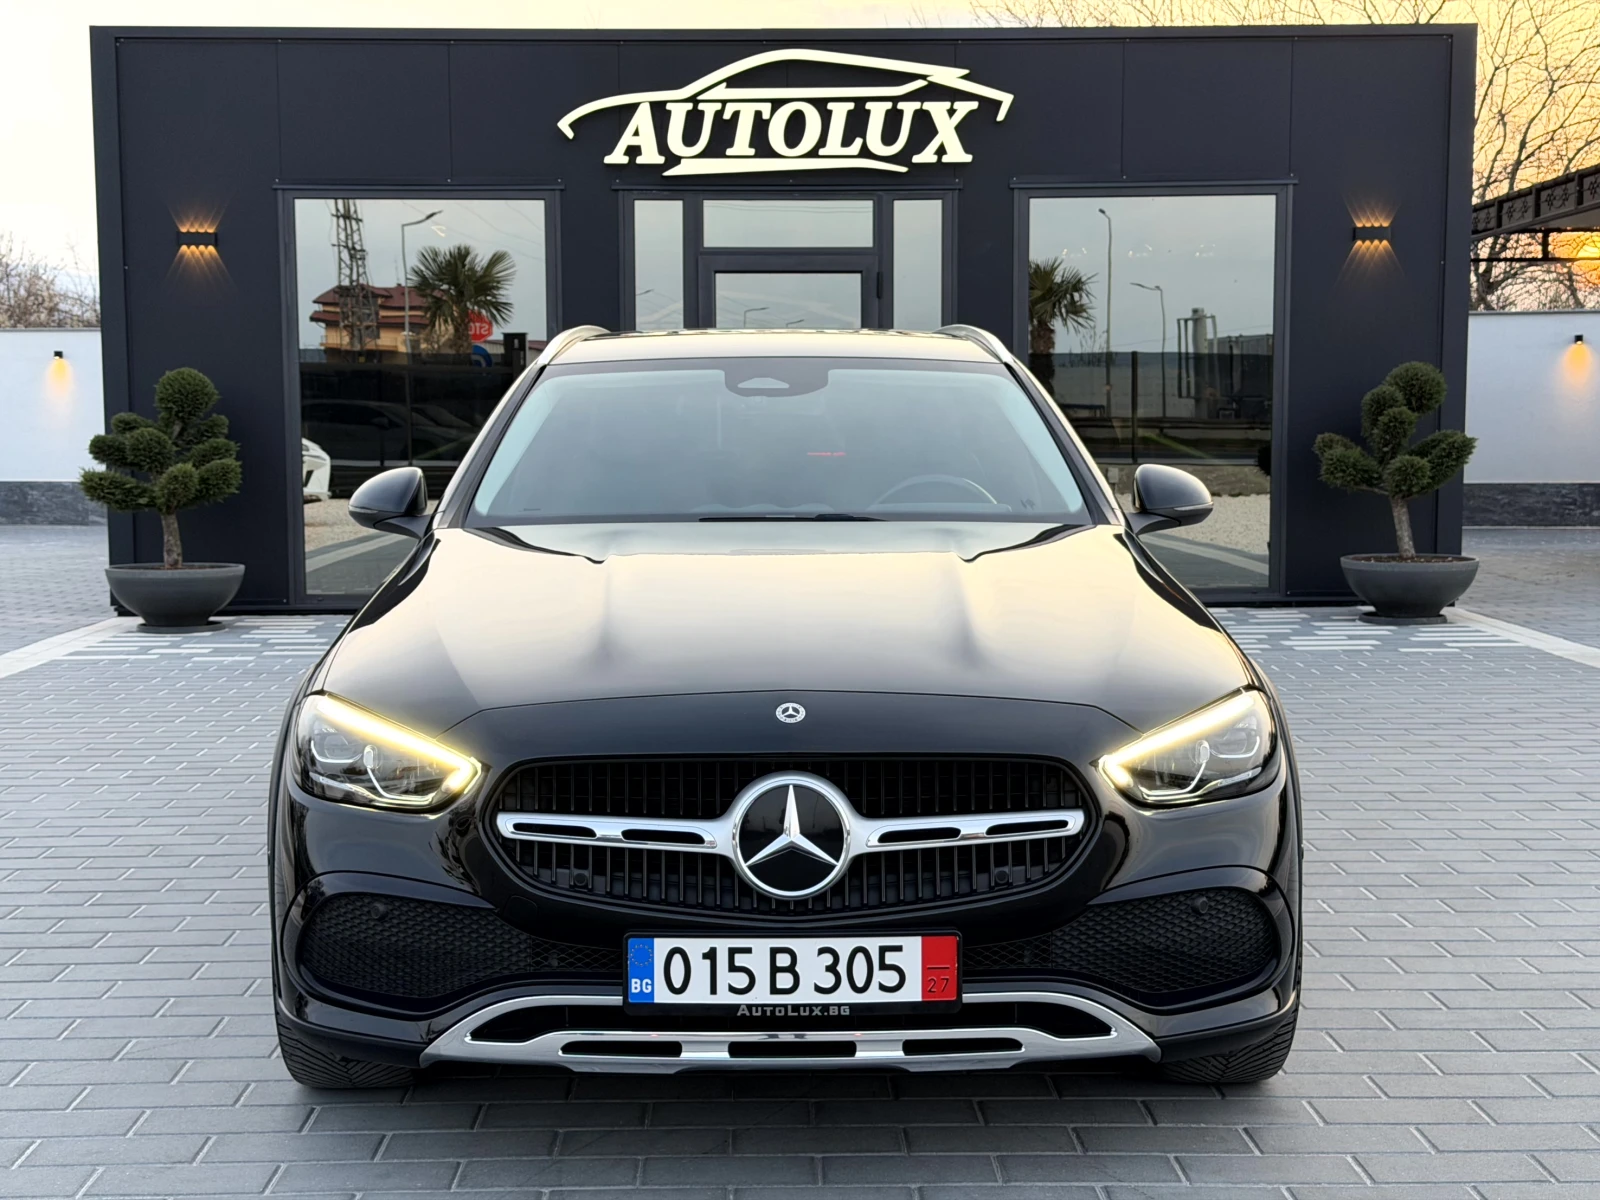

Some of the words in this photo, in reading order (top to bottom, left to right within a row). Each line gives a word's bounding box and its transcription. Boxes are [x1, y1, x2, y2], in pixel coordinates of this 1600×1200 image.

[603, 101, 979, 164] AUTOLUX
[631, 978, 652, 993] BG
[664, 946, 756, 996] 015
[813, 944, 907, 994] 305
[927, 977, 950, 993] 27
